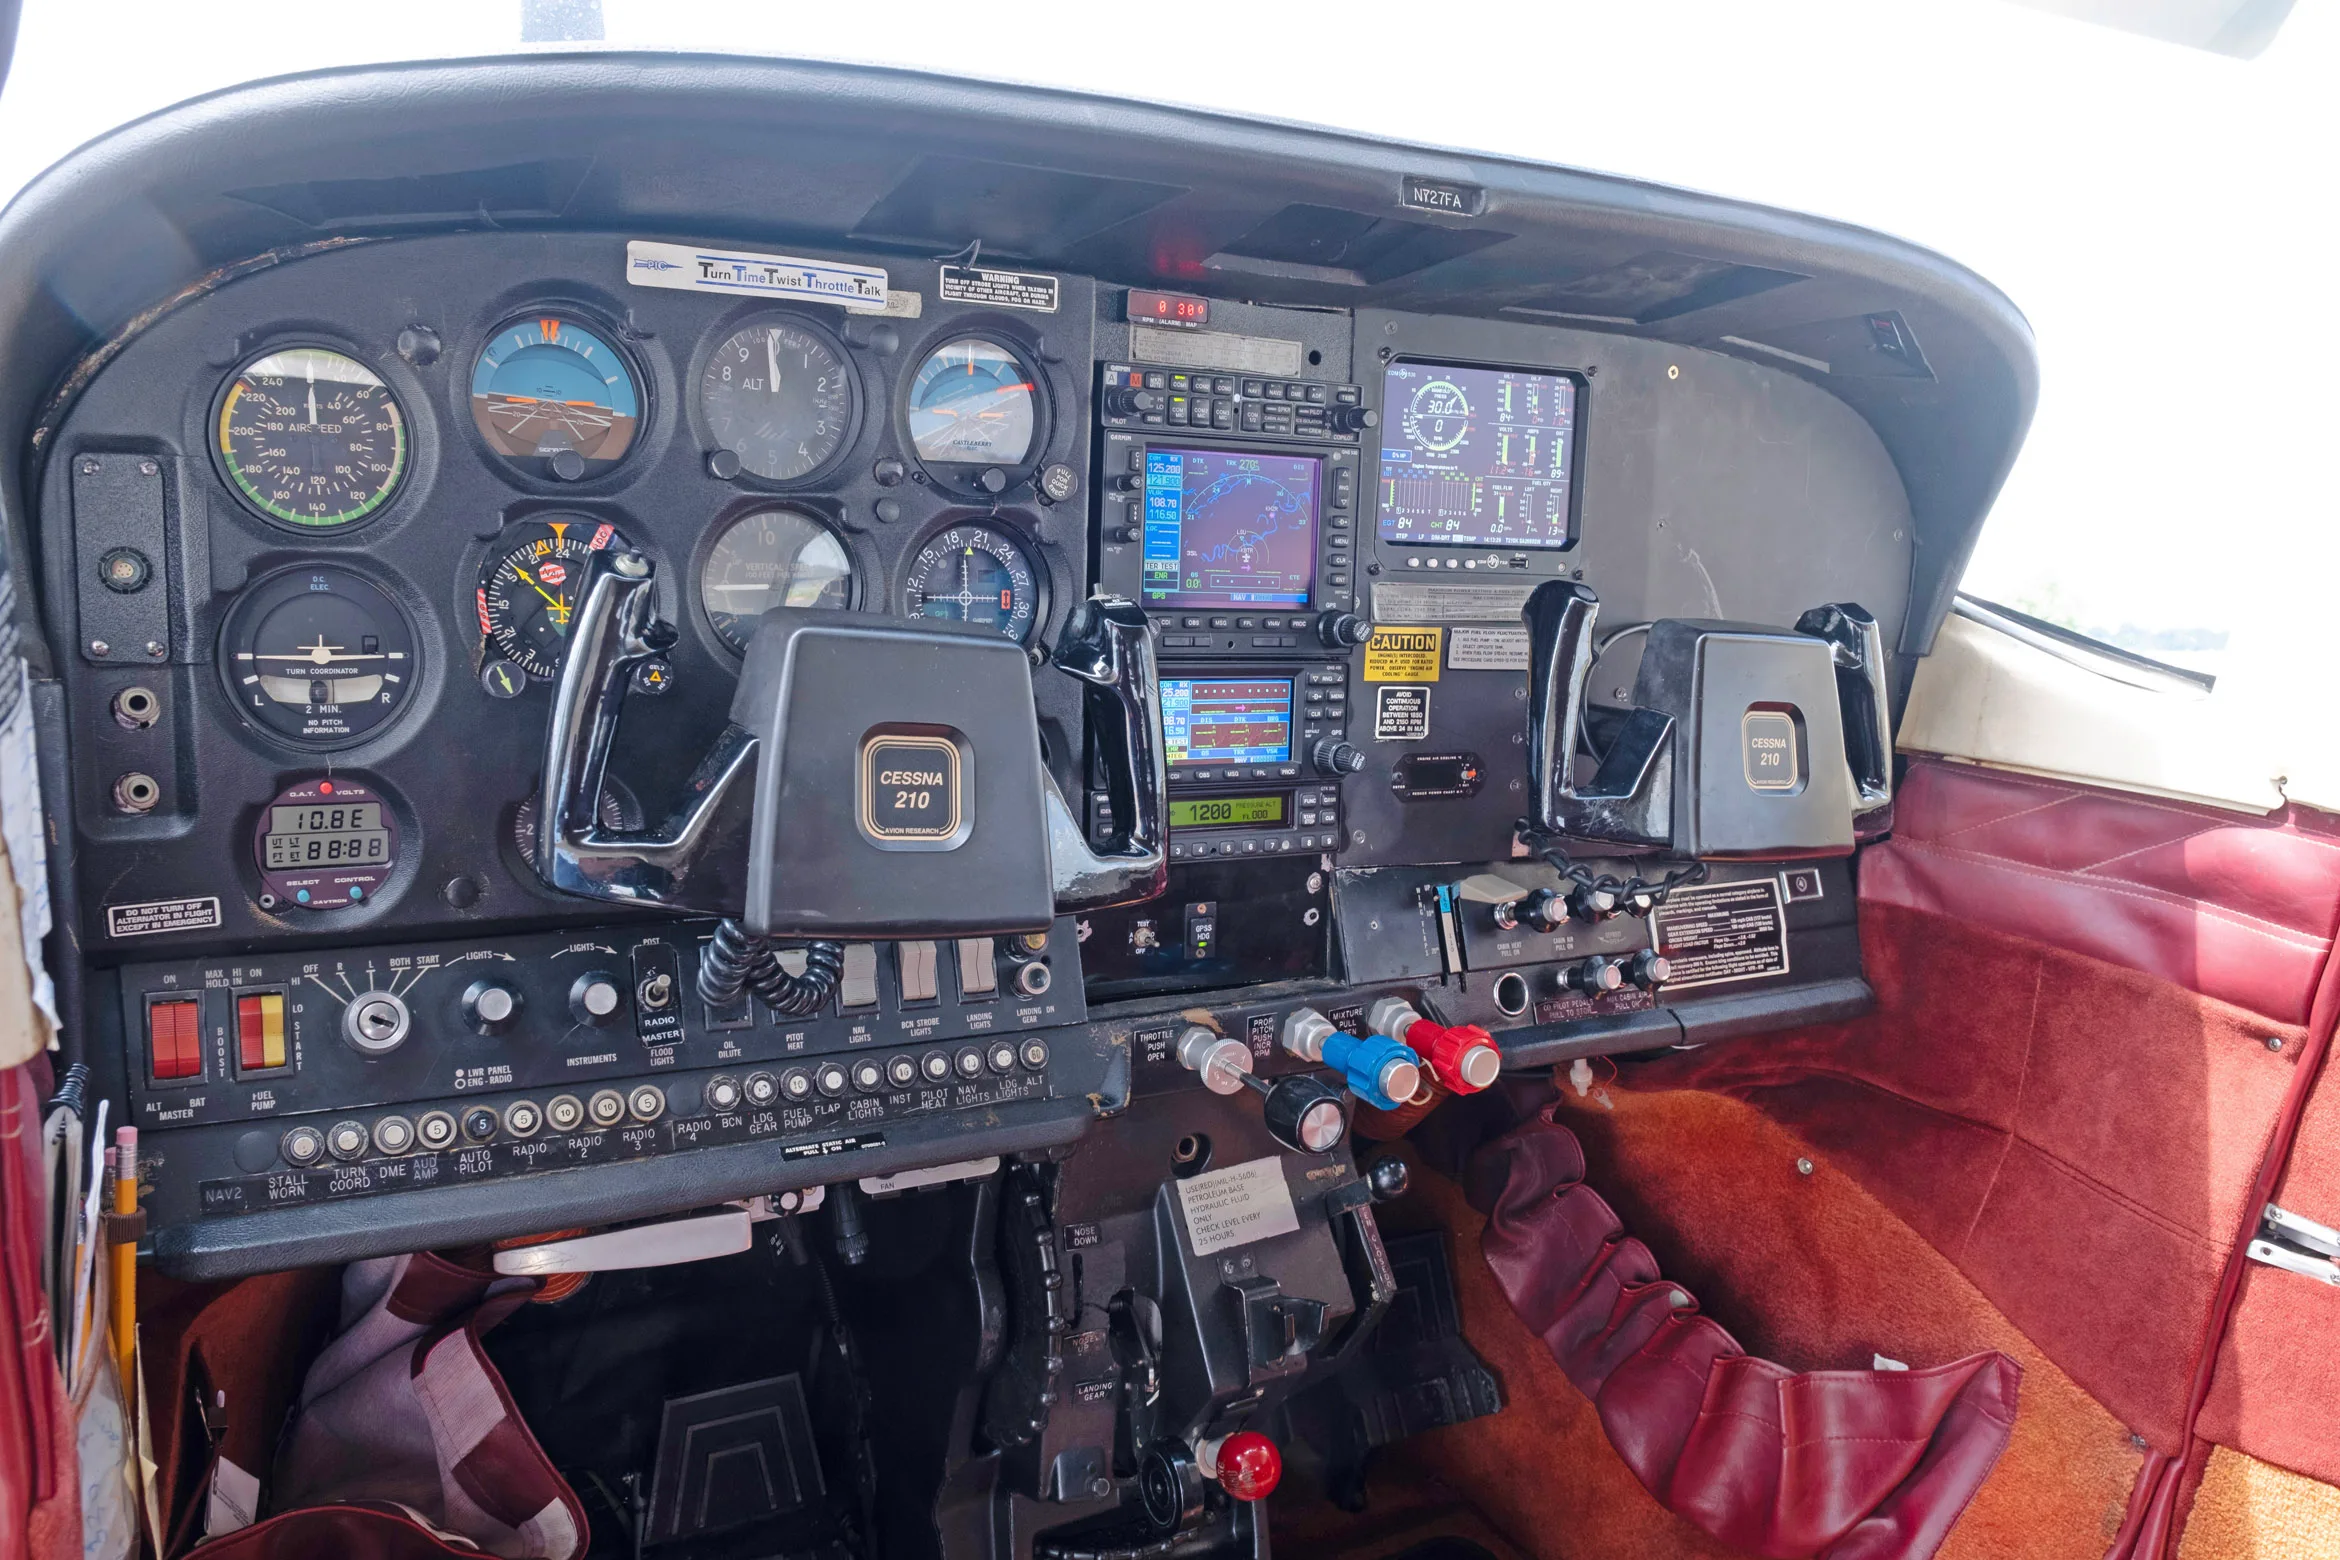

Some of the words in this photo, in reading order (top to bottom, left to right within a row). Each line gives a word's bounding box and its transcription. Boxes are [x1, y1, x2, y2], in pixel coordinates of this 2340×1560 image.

[1414, 187, 1461, 208] N727FA
[648, 260, 668, 271] PIC
[698, 262, 731, 280] Turn
[732, 265, 766, 283] Time
[764, 268, 801, 286] Twist
[802, 272, 854, 292] Throttle
[854, 278, 880, 296] Talk
[981, 273, 1020, 284] WARNING
[739, 347, 749, 362] 9
[722, 366, 732, 381] 8
[742, 378, 764, 390] ALT
[817, 377, 826, 392] 2
[246, 393, 266, 402] 220
[234, 427, 254, 436] 200
[815, 420, 826, 435] 3
[245, 465, 262, 473] 180
[371, 464, 387, 472] 100
[1148, 463, 1181, 474] 125.200
[273, 491, 290, 499] 160
[350, 491, 366, 500] 120
[309, 503, 326, 511] 140
[1149, 497, 1177, 508] 108.70
[1398, 517, 1412, 529] 84
[943, 531, 960, 545] 18
[973, 530, 989, 544] 21
[998, 543, 1016, 560] 24
[1370, 635, 1435, 650] CAUTION
[310, 667, 358, 675] COORDINATOR
[254, 694, 264, 706] L
[381, 692, 391, 704] R
[306, 705, 312, 714] 2
[320, 704, 342, 713] MIN.
[303, 726, 350, 734] INFORMATION
[1752, 738, 1786, 748] CESSNA
[1760, 753, 1780, 766] 210
[880, 771, 943, 785] CESSNA
[289, 790, 316, 798] O.A.T.
[894, 791, 930, 809] 210
[1189, 803, 1231, 822] 1200
[307, 837, 382, 860] 88:88
[286, 878, 320, 886] SELECT
[334, 875, 376, 883] CONTROL
[161, 905, 184, 913] TURN
[117, 914, 170, 925] ALTERNATOR
[184, 909, 212, 918] FLIGHT
[116, 924, 150, 932] EXCEPT
[163, 916, 213, 927] EMERGENCY
[1195, 924, 1212, 932] GPSS
[569, 943, 595, 952] LIGHTS
[416, 954, 440, 965] START
[466, 951, 493, 960] LIGHTS
[337, 962, 343, 971] R
[368, 960, 374, 968] L
[390, 956, 411, 967] BOTH
[205, 969, 223, 979] MAX
[232, 968, 242, 977] HI
[249, 968, 262, 978] ON
[303, 964, 319, 974] OFF
[163, 974, 176, 984] ON
[206, 978, 230, 988] HOLD
[232, 976, 242, 986] IN
[291, 977, 300, 986] HI
[292, 1004, 304, 1014] LO
[644, 1016, 675, 1027] RADIO
[966, 1011, 993, 1023] LANDING
[1253, 1017, 1273, 1027] PROP
[969, 1018, 991, 1030] LIGHTS
[1252, 1025, 1274, 1034] PITCH
[641, 1029, 680, 1043] MASTER
[852, 1026, 866, 1035] NAV
[1140, 1030, 1174, 1041] THROTTLE
[785, 1032, 804, 1043] PITOT
[849, 1032, 871, 1044] LIGHTS
[1253, 1033, 1273, 1042] PUSH
[723, 1040, 735, 1050] OIL
[787, 1040, 804, 1051] HEAT
[1147, 1042, 1165, 1051] PUSH
[1253, 1041, 1271, 1049] INCR
[650, 1047, 673, 1057] FLOOD
[718, 1046, 742, 1058] DILUTE
[1147, 1052, 1165, 1061] OPEN
[1254, 1048, 1271, 1057] RPM
[567, 1053, 617, 1067] INSTRUMENTS
[650, 1056, 675, 1066] LIGHTS
[468, 1067, 484, 1078] LWR
[487, 1065, 512, 1075] PANEL
[252, 1090, 274, 1102] FUEL
[889, 1092, 912, 1105] INST
[146, 1102, 162, 1112] ALT
[189, 1096, 206, 1108] BAT
[251, 1099, 276, 1111] PUMP
[849, 1098, 880, 1111] CABIN
[782, 1107, 811, 1120] FUEL
[814, 1102, 841, 1115] FLAP
[848, 1106, 884, 1120] LIGHTS
[159, 1108, 194, 1121] MASTER
[721, 1116, 743, 1128] BCN
[784, 1116, 813, 1129] PUMP
[568, 1135, 603, 1150] RADIO
[512, 1142, 548, 1157] RADIO
[580, 1147, 588, 1158] 2
[460, 1150, 491, 1165] AUTO
[528, 1155, 533, 1165] 1
[380, 1164, 407, 1179] DME
[459, 1159, 493, 1173] PILOT
[334, 1166, 366, 1179] TURN
[268, 1173, 308, 1189] STALL
[329, 1177, 370, 1192] COORD
[880, 1182, 895, 1190] FAN
[205, 1186, 243, 1203] NAV2
[268, 1184, 306, 1200] WORN
[1188, 1189, 1228, 1204] PETROLEUM
[1228, 1184, 1245, 1194] BASE
[1190, 1199, 1229, 1214] HYDRAULIC
[1193, 1214, 1212, 1224] ONLY
[1196, 1223, 1220, 1235] CHECK
[1221, 1218, 1240, 1228] LEVEL
[1242, 1212, 1261, 1223] EVERY
[1074, 1226, 1096, 1236] NOSE
[1074, 1235, 1098, 1246] DOWN
[1199, 1237, 1208, 1246] 25
[1209, 1230, 1235, 1242] HOURS
[1078, 1382, 1113, 1395] LANDING
[1084, 1391, 1105, 1401] GEAR
